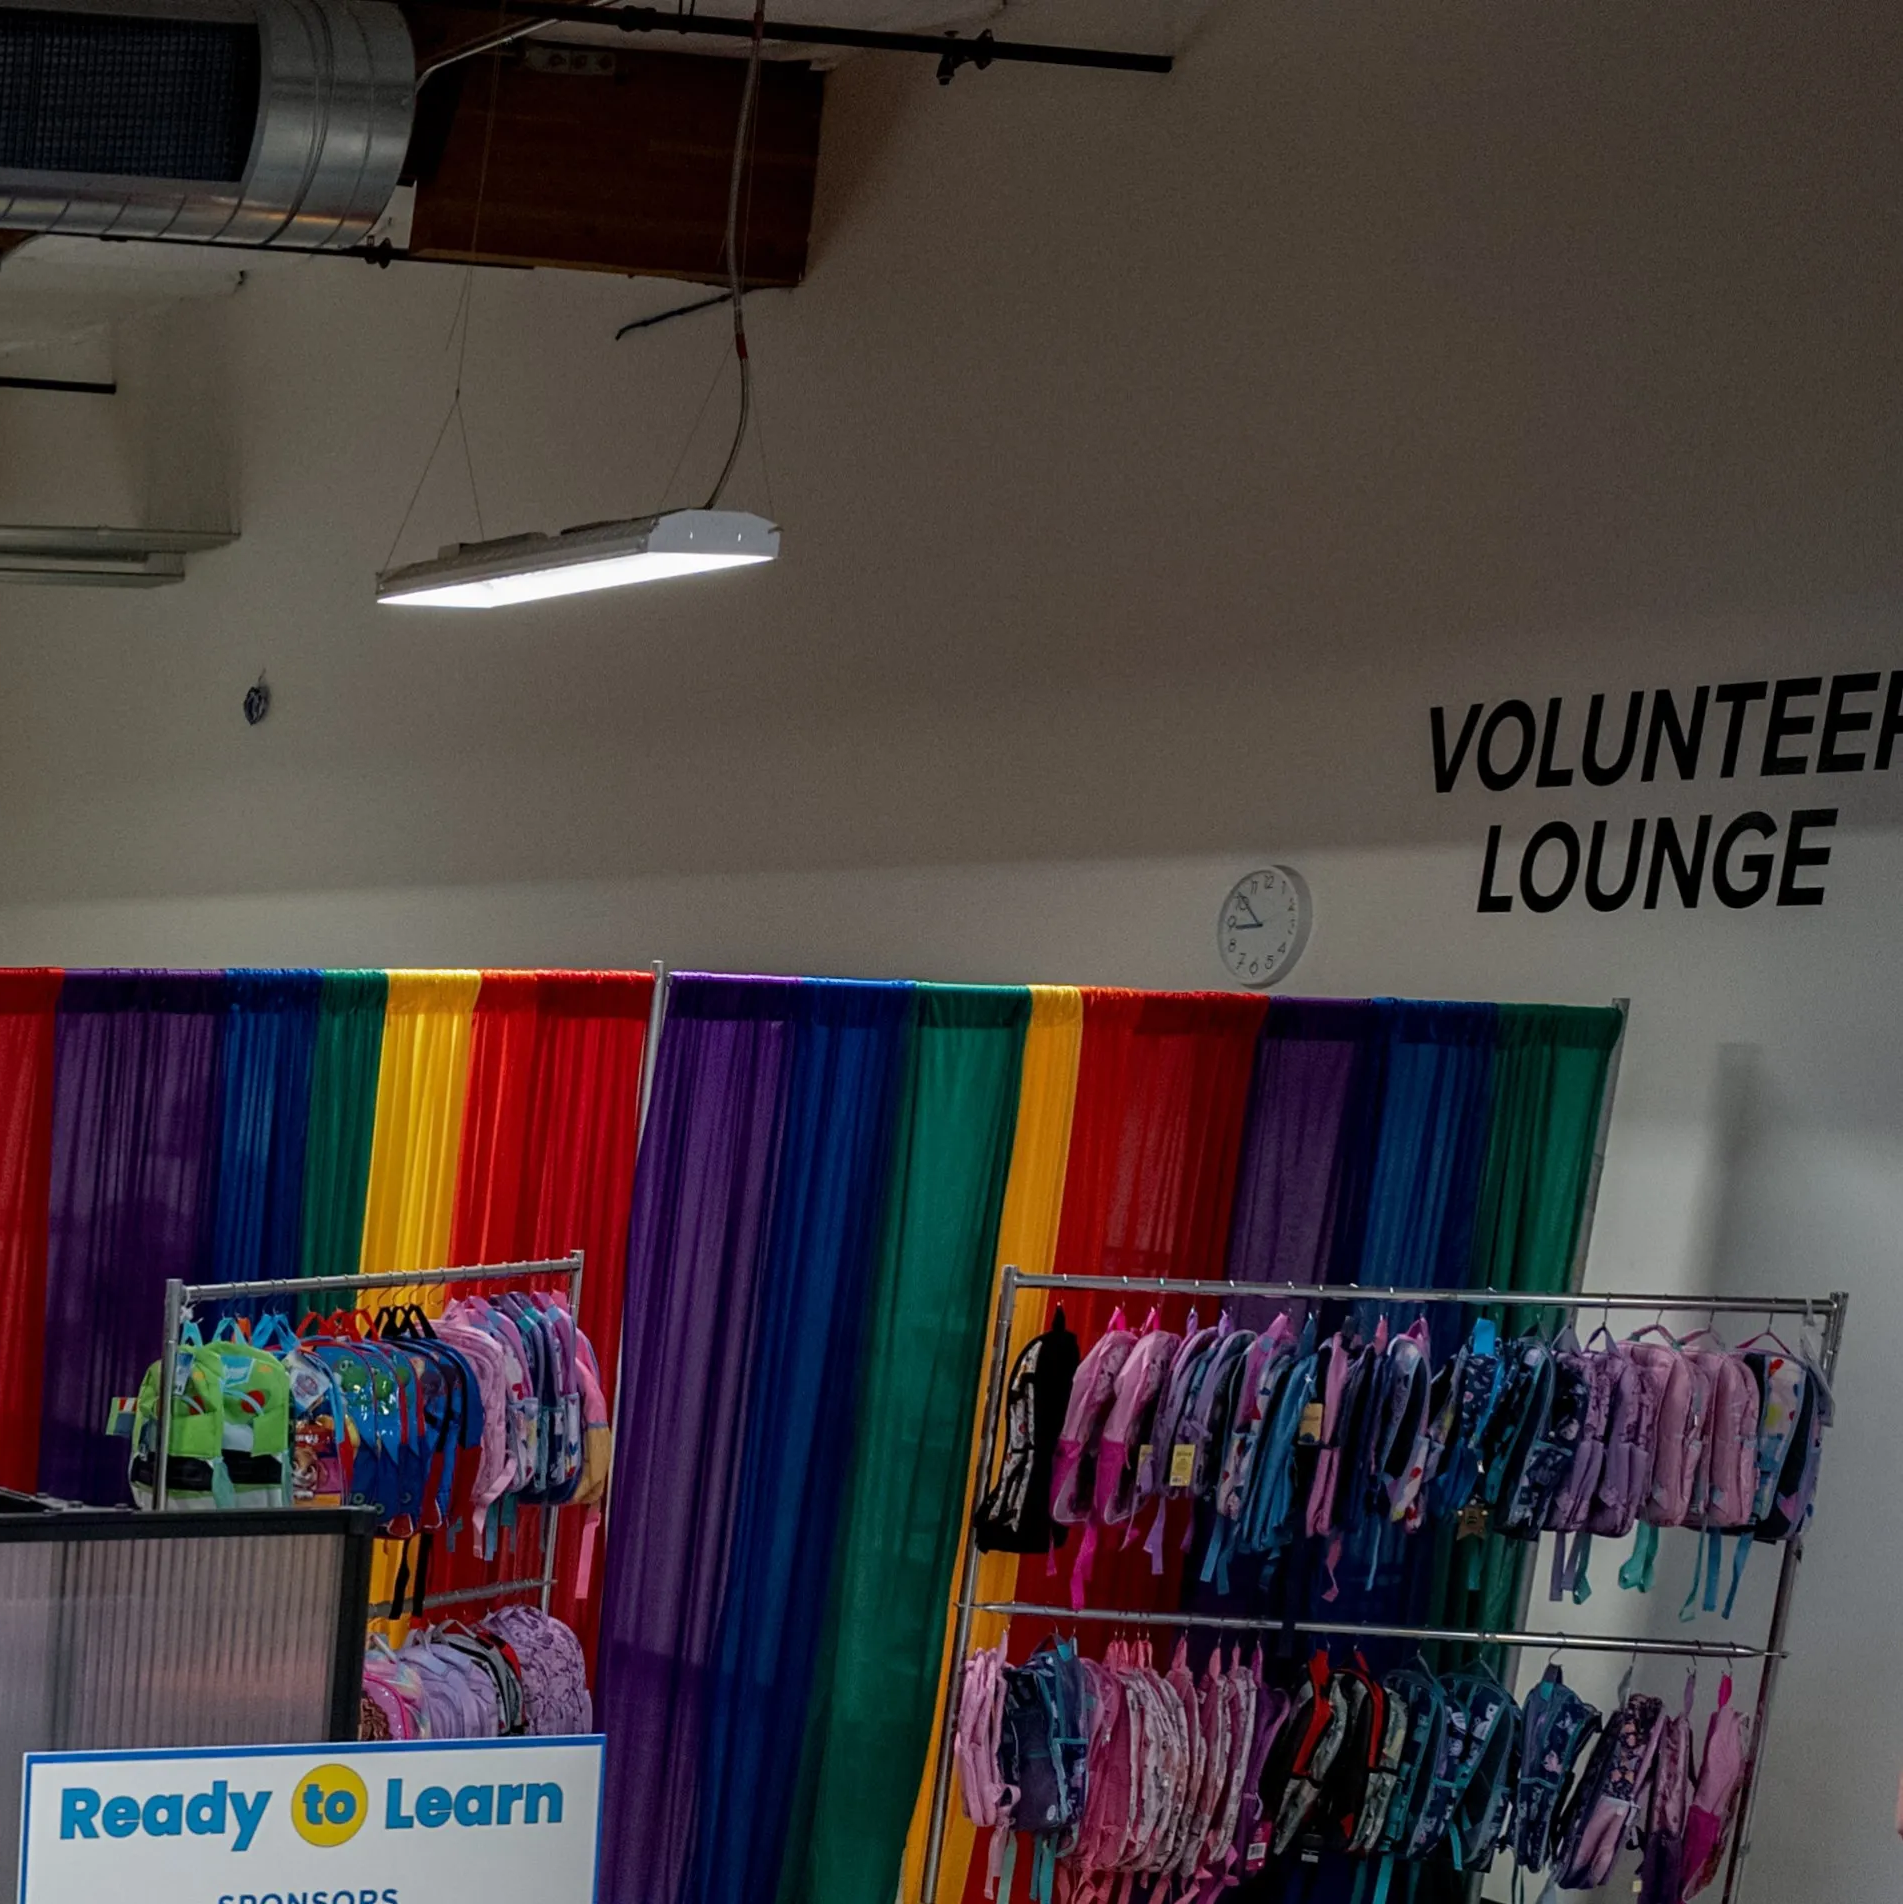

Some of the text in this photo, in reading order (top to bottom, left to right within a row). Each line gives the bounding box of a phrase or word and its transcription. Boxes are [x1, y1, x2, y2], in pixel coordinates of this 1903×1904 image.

[1264, 874, 1274, 890] 12
[1477, 808, 1839, 913] LOUNGE
[60, 1777, 564, 1852] Ready to Learn
